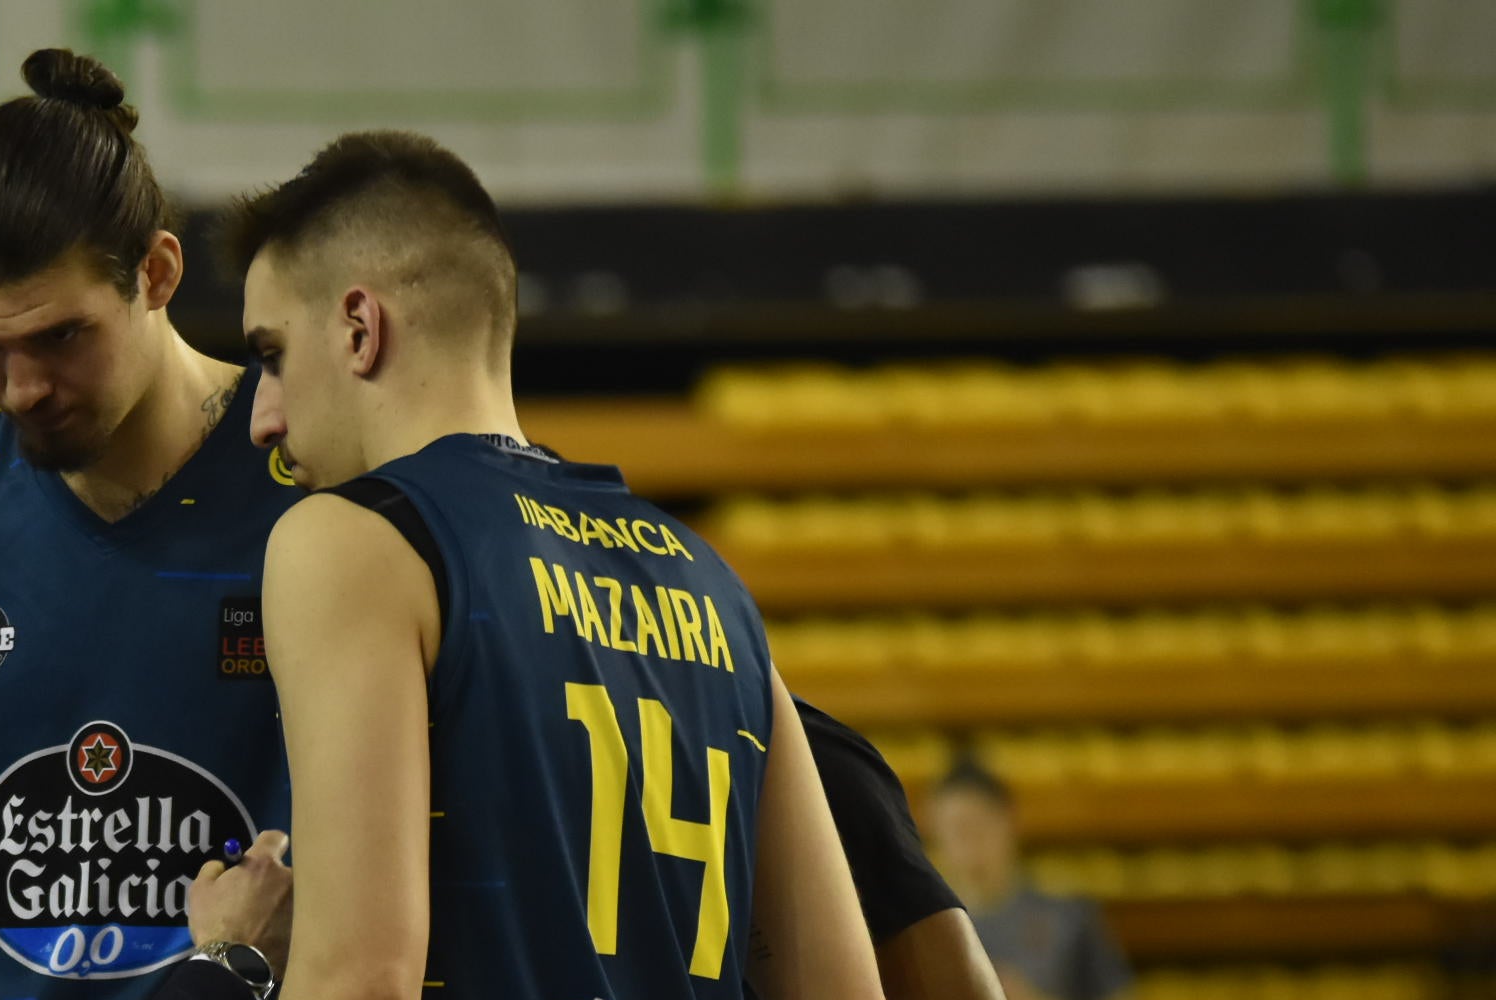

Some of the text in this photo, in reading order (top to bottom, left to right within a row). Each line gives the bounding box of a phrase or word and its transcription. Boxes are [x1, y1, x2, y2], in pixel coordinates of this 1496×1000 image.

[224, 608, 255, 627] Liga
[528, 556, 735, 673] MAZAIRA
[222, 658, 267, 674] ORO
[564, 682, 731, 981] 14
[6, 858, 194, 920] Galicia
